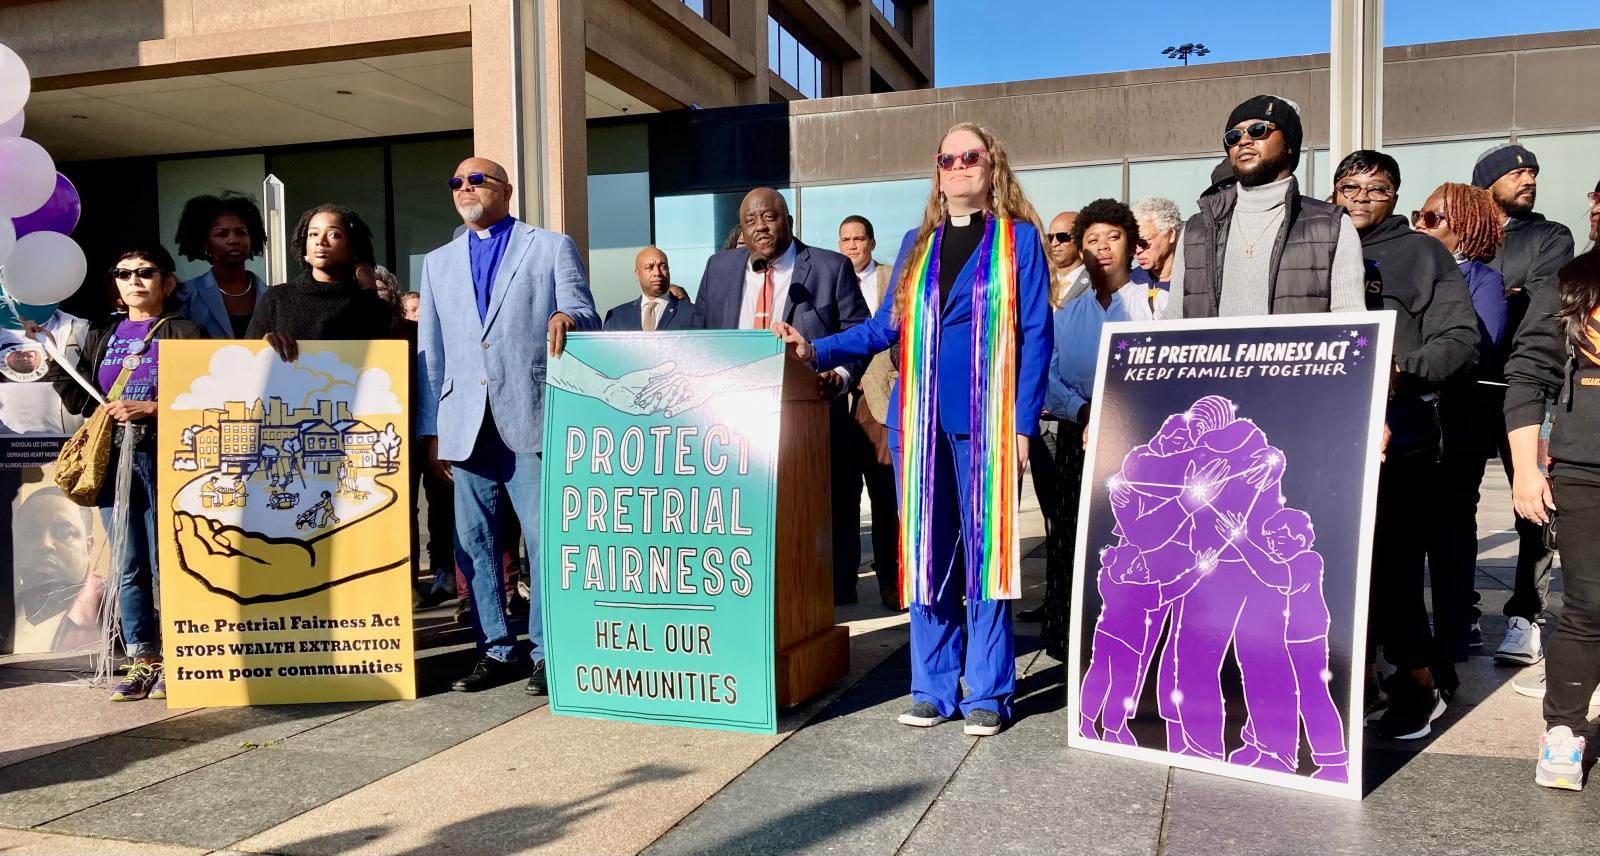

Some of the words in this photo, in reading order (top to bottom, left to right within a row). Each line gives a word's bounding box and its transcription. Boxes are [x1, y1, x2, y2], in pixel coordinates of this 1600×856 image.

[1127, 346, 1155, 365] THE
[1158, 343, 1232, 364] PRETRIAL
[1235, 342, 1314, 363] FAIRNESS
[1315, 340, 1351, 361] ACT
[1124, 366, 1173, 381] KEEPS
[1177, 364, 1253, 380] FAMILIES
[1260, 361, 1348, 377] TOGETHER
[565, 424, 753, 476] PROTECT
[561, 486, 753, 535] PRETRIAL
[561, 545, 752, 598] FAIRNESS
[174, 620, 210, 634] The
[214, 617, 285, 633] Pretrial
[290, 616, 367, 630] Fairness
[371, 613, 401, 628] Act
[594, 620, 655, 653] HEAL
[664, 624, 713, 657] OUR
[176, 644, 226, 658] STOPS
[228, 641, 294, 656] WEALTH
[299, 638, 401, 654] EXTRACTION
[177, 666, 224, 681] from
[229, 667, 273, 682] poor
[277, 659, 403, 677] communities
[575, 665, 738, 706] COMMUNITIES
